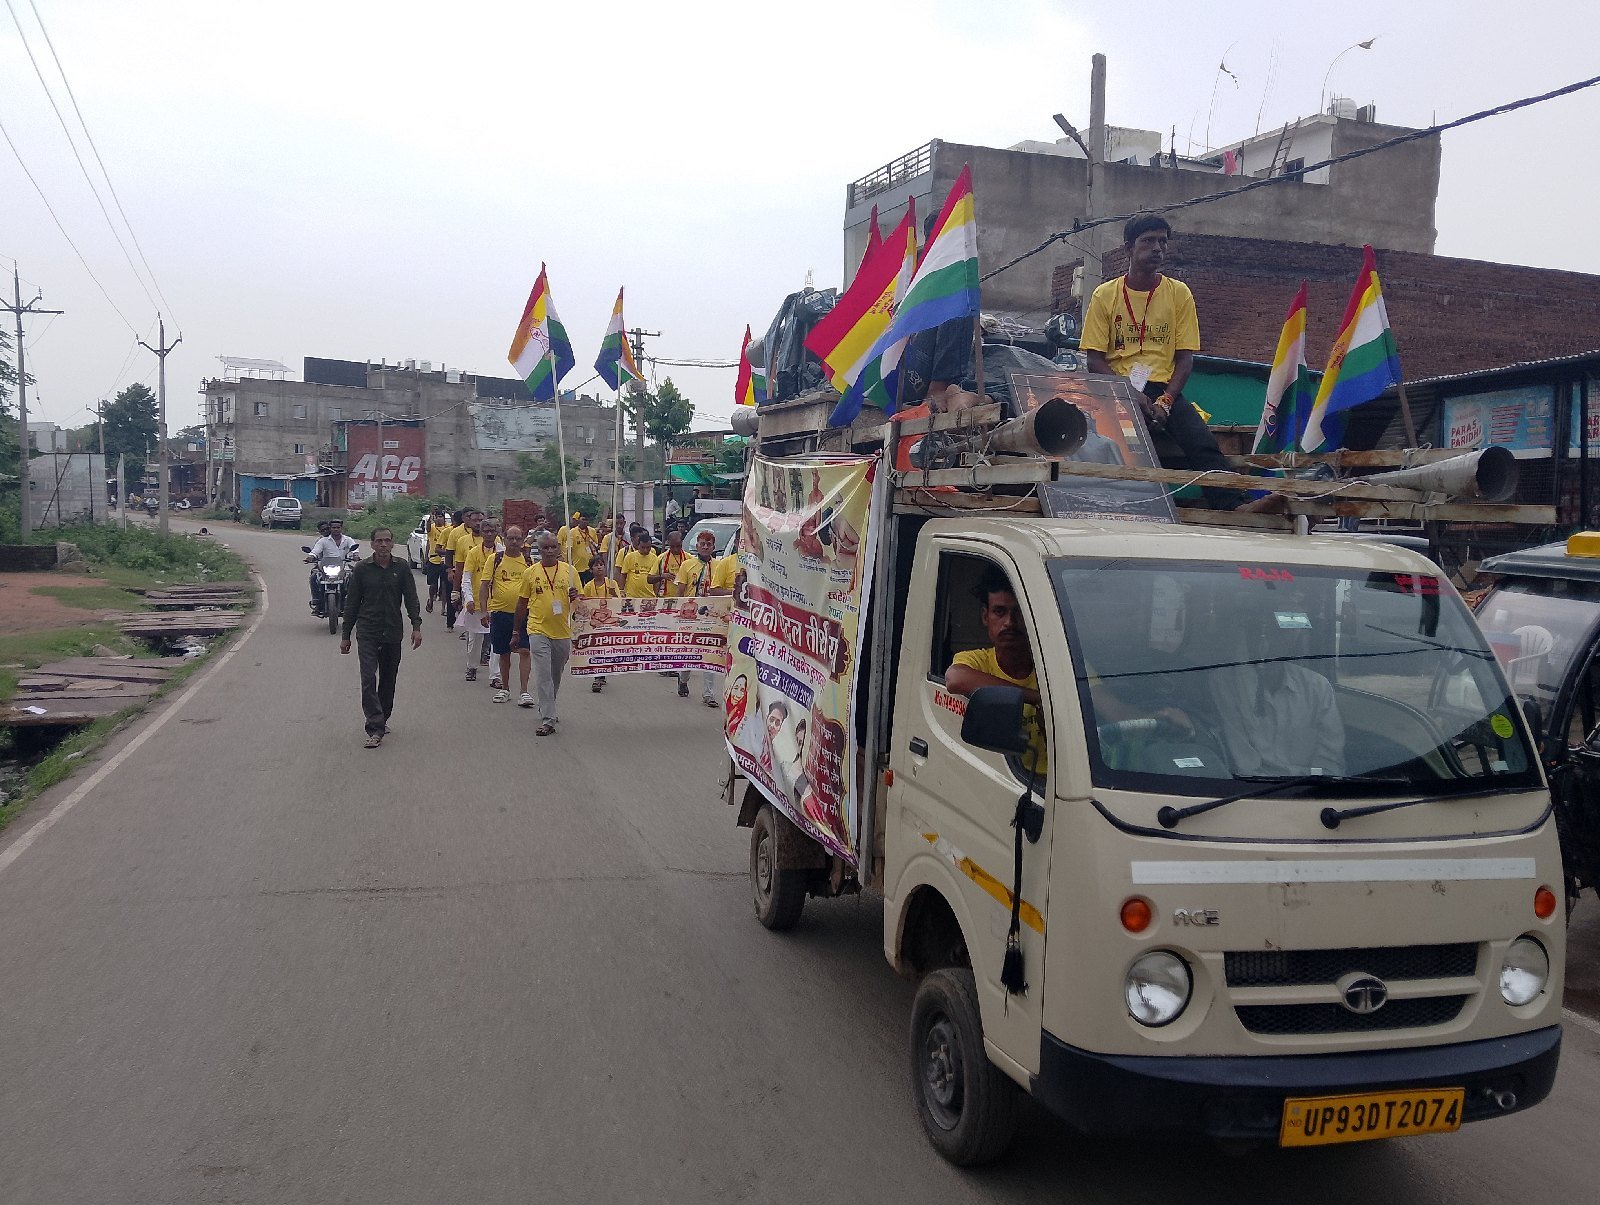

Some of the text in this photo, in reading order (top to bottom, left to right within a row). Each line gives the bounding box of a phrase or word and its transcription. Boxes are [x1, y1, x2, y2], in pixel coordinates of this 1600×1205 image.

[1451, 419, 1477, 438] PARAS
[348, 453, 421, 481] ACC
[641, 631, 668, 645] पैदल
[670, 632, 695, 644] तीर्थ
[696, 635, 722, 646] यात्रा
[1303, 1098, 1459, 1137] UP93DT2074
